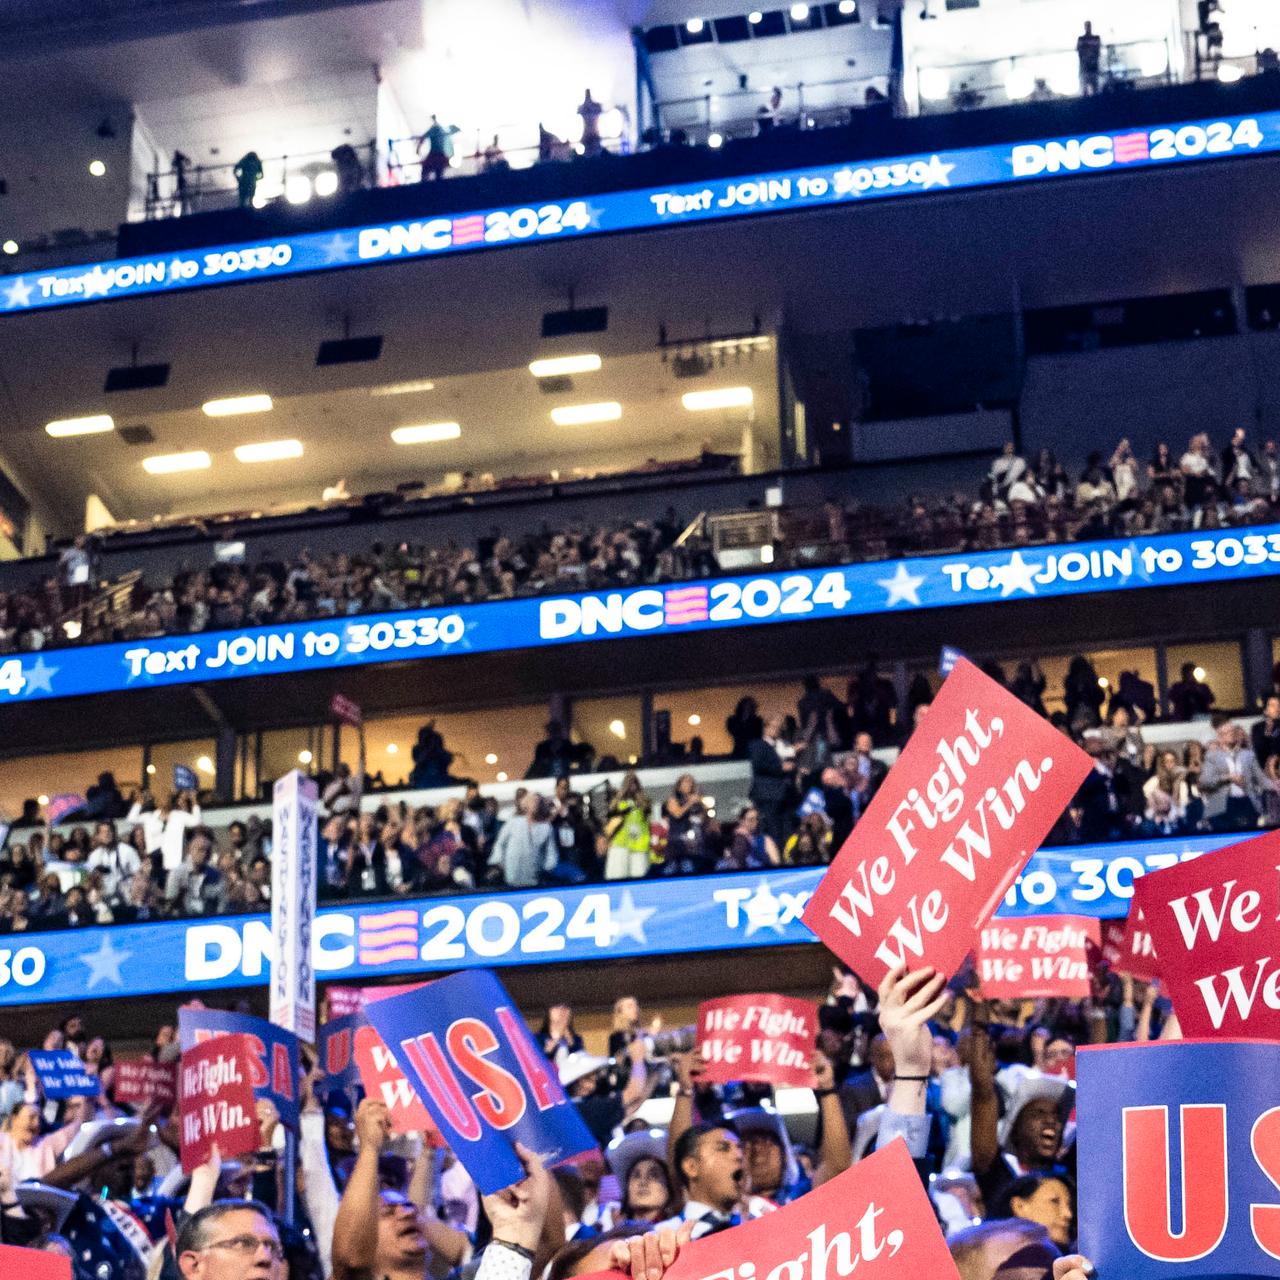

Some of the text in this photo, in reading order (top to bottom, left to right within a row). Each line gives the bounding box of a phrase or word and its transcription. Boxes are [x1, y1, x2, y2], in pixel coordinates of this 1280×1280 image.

[1012, 119, 1264, 177] DNC 2024
[650, 188, 714, 217] Text
[718, 179, 791, 210] JOIN
[796, 173, 828, 197] to
[358, 205, 592, 260] DNC 2024
[170, 255, 199, 280] to
[203, 243, 292, 277] 30330
[1035, 548, 1132, 583] JOIN
[1141, 546, 1183, 574] to
[538, 571, 851, 641] DNC 2024
[125, 613, 466, 677] Text JOIN to 30330
[830, 706, 1006, 939] We Fight,
[874, 755, 1053, 975] We Win.
[421, 894, 619, 962] 2024
[979, 927, 1019, 952] We
[1168, 879, 1262, 953] We
[981, 958, 1024, 983] We
[705, 1006, 810, 1039] We Fight,
[199, 1054, 244, 1097] Fight,
[400, 1006, 568, 1143] USA
[701, 1039, 810, 1071] We Win.
[202, 1100, 252, 1136] Win.
